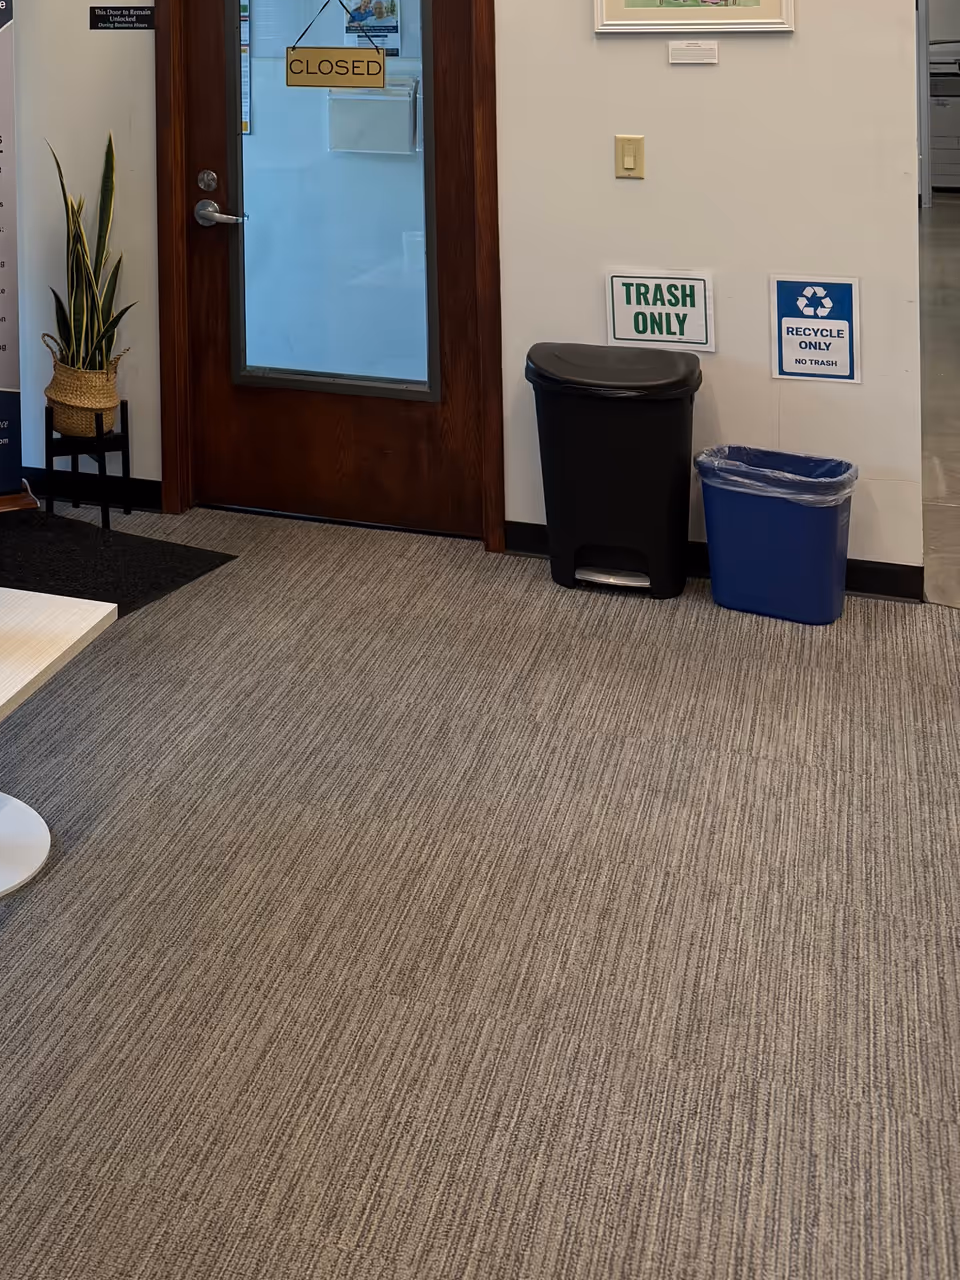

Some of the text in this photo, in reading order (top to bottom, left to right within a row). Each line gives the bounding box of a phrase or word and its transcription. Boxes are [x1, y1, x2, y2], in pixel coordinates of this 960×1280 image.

[290, 59, 381, 75] CLOSED
[622, 282, 696, 307] TRASH
[633, 312, 687, 336] ONLY
[786, 327, 845, 338] RECYCLE
[799, 341, 831, 351] ONLY
